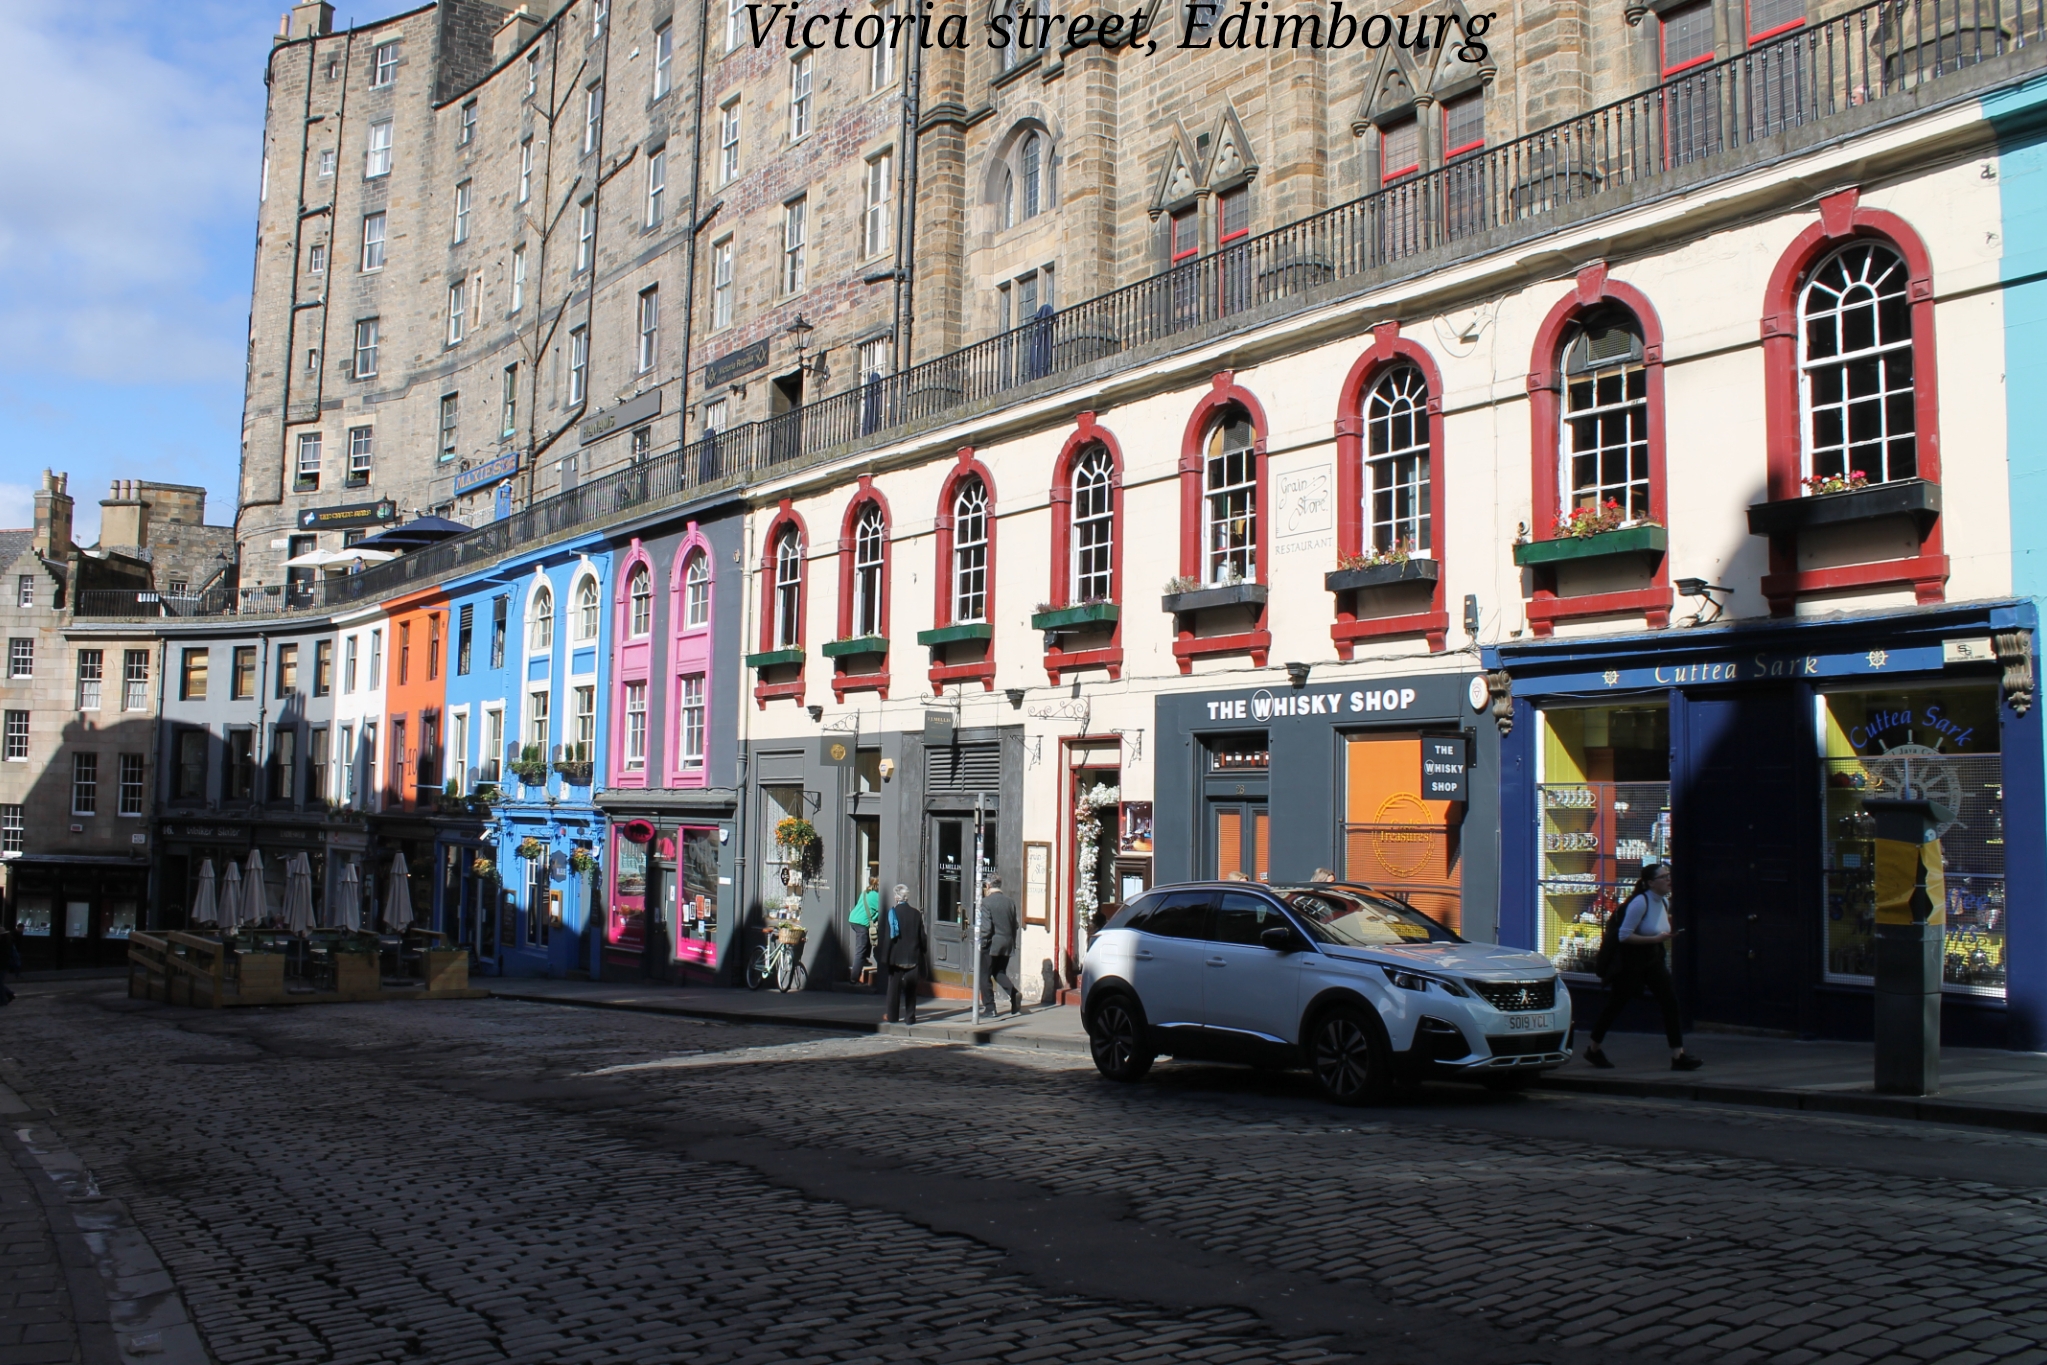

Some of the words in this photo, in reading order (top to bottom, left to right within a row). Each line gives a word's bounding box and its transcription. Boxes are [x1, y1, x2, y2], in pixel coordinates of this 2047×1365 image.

[583, 414, 616, 439] HANAMS
[456, 461, 502, 490] MAXIES
[1279, 476, 1308, 510] Grain
[1275, 537, 1333, 555] RESTAURANT
[1654, 659, 1737, 684] Cuttea
[1753, 649, 1819, 678] Sark
[1207, 699, 1247, 720] THE
[1254, 691, 1343, 719] WHISKY
[1349, 688, 1416, 712] SHOP
[1850, 709, 1913, 749] Cuttea
[1921, 705, 1974, 747] Sark
[406, 748, 418, 775] 40
[1434, 745, 1454, 755] THE
[1899, 747, 1917, 755] Java
[1425, 762, 1464, 774] WHISKY
[1431, 780, 1458, 792] SHOP
[1510, 1016, 1530, 1029] SO19
[1532, 1015, 1548, 1028] YCL
